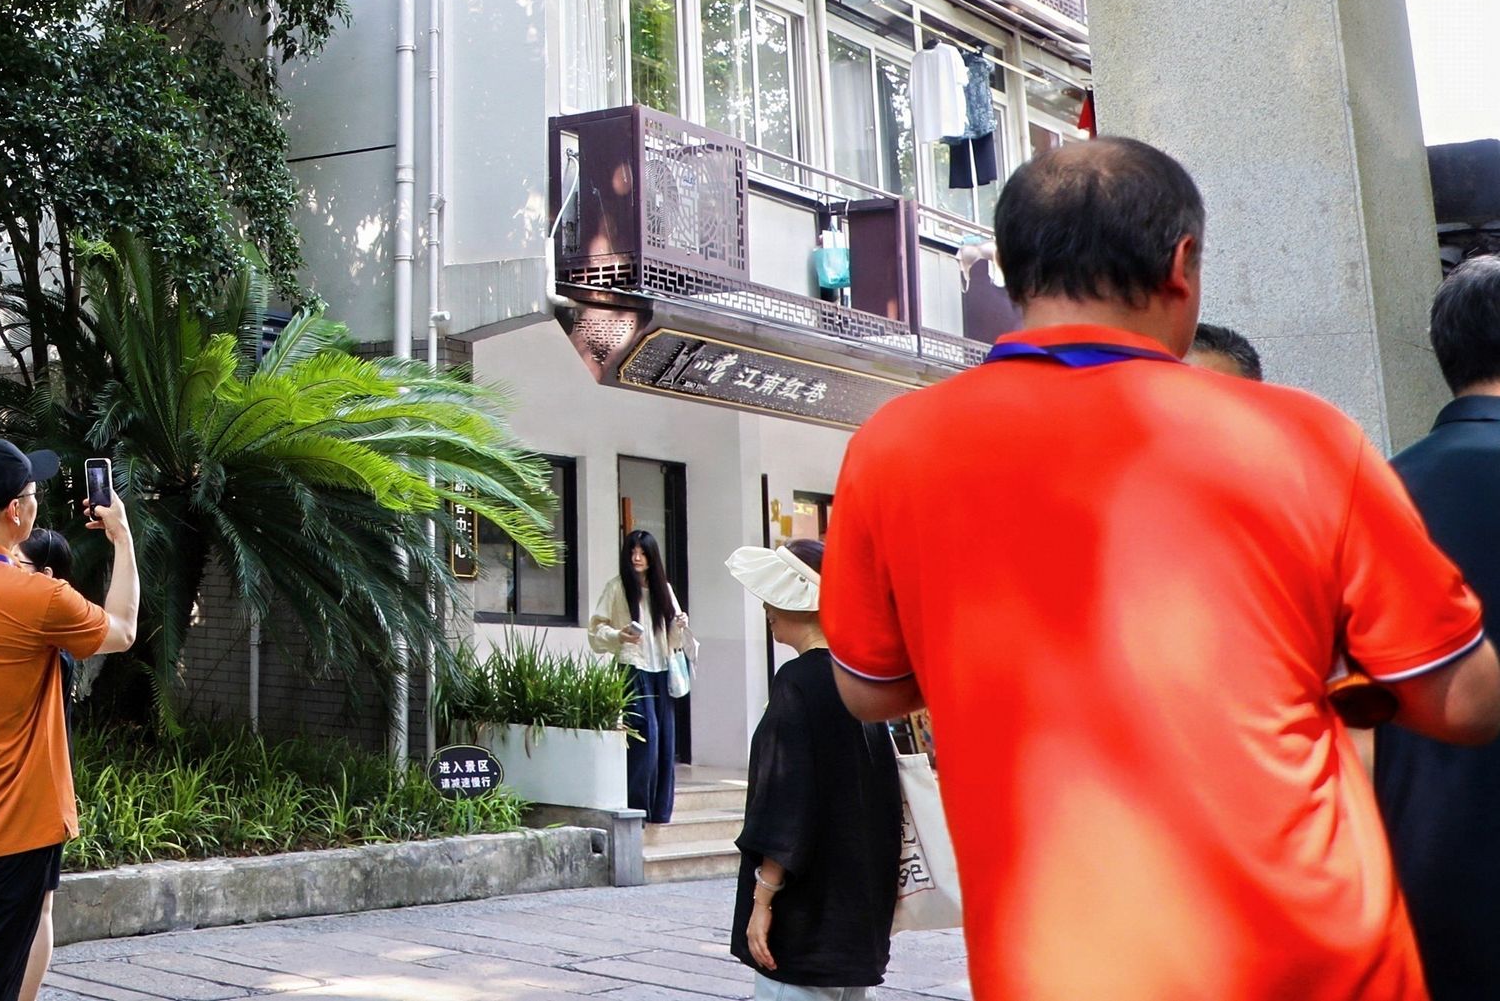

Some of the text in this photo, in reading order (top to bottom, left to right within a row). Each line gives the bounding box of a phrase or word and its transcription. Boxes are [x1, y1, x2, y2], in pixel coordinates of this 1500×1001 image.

[439, 760, 490, 773] 进入景区
[441, 777, 491, 788] 请减速慢行
